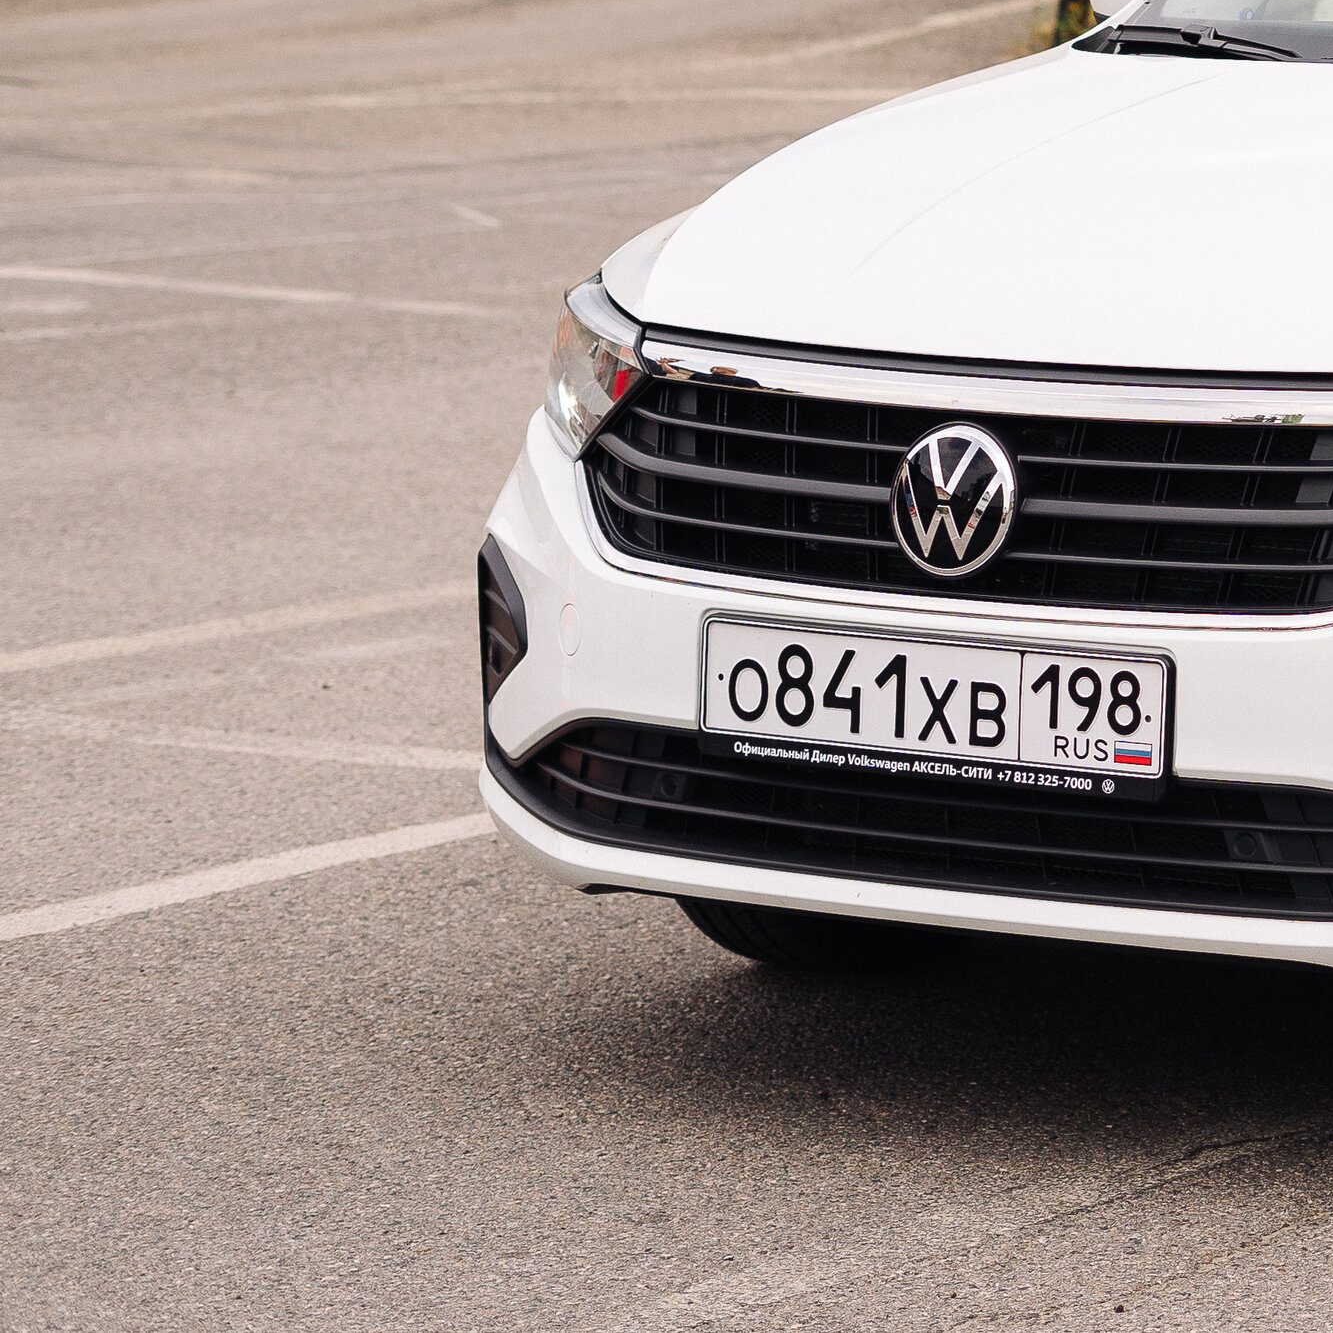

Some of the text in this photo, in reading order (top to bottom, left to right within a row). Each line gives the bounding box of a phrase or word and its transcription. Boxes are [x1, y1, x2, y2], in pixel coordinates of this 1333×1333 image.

[1029, 663, 1142, 736] 198
[733, 741, 1093, 791] Официальный Дилер Volkswagen АКСЕЛЬ-СИТИ +7 812 325-7000
[1053, 736, 1109, 762] RUS
